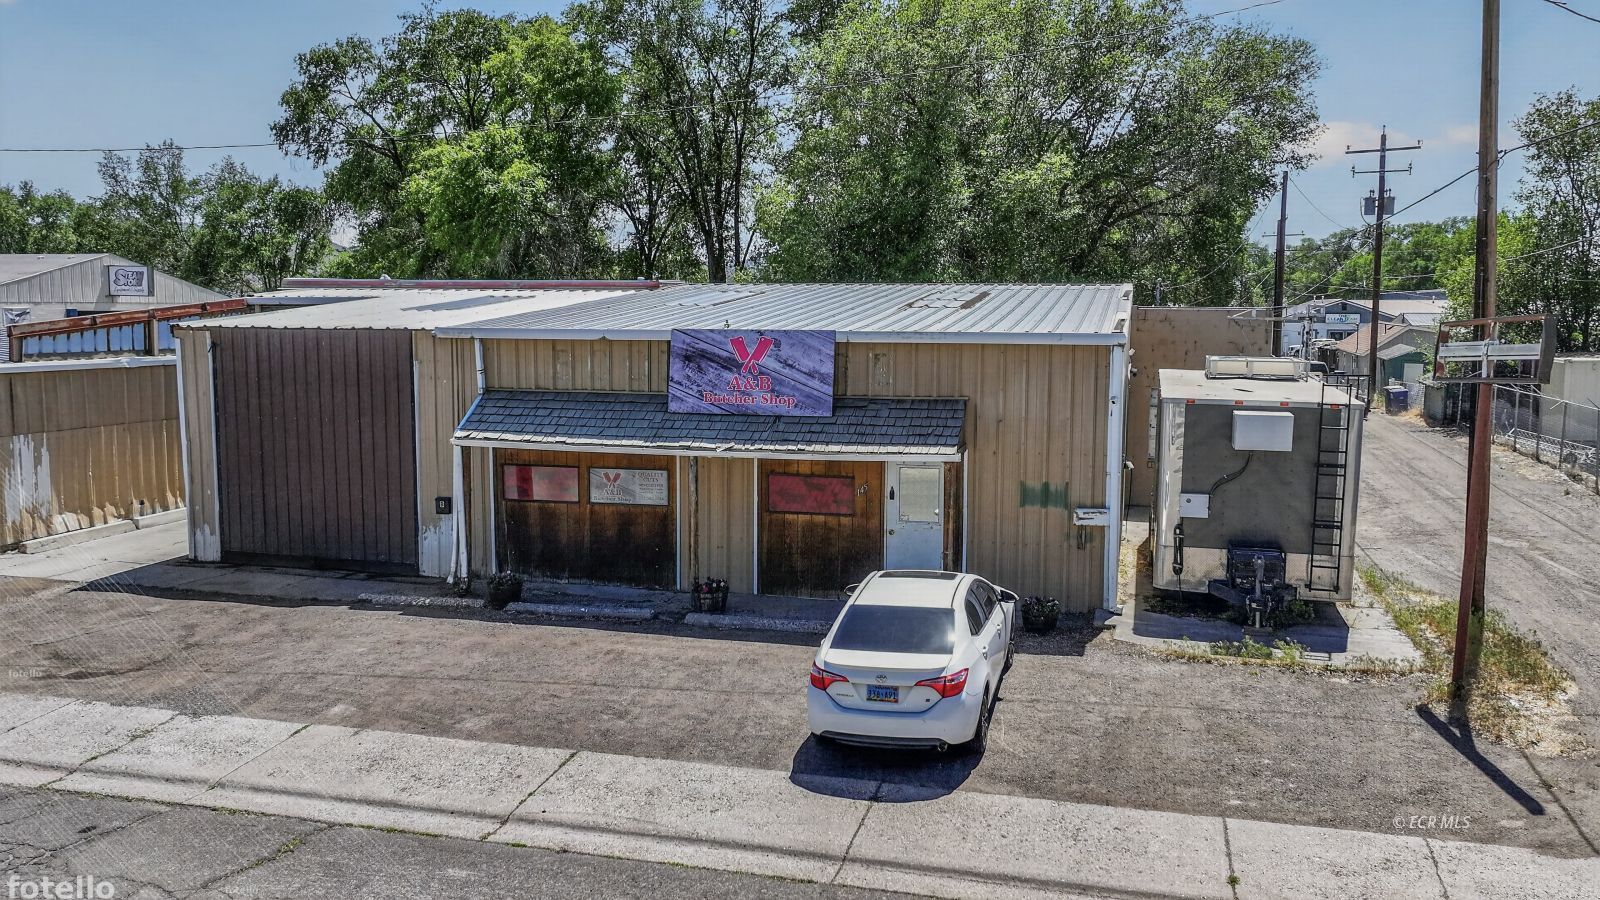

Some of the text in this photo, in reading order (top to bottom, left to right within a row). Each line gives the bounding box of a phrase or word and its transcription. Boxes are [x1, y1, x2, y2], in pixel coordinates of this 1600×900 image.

[727, 375, 772, 391] A&B
[703, 392, 796, 409] Butcher Shop
